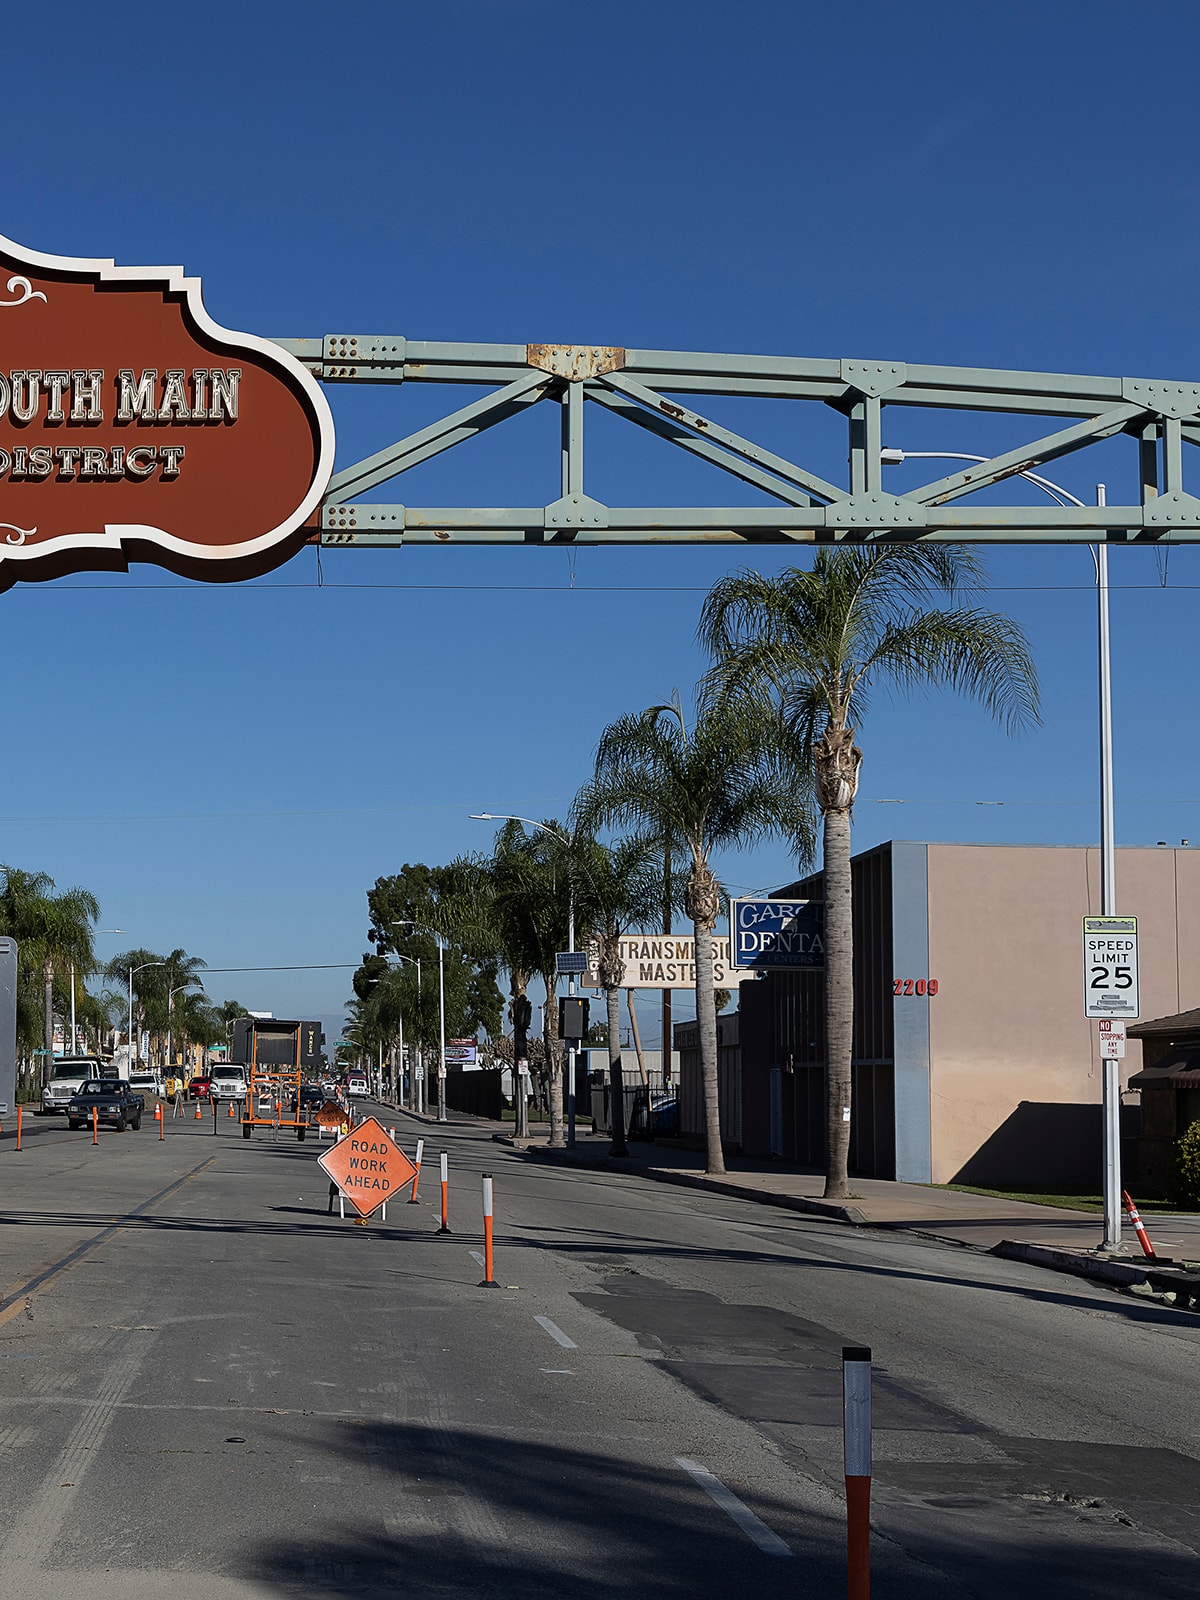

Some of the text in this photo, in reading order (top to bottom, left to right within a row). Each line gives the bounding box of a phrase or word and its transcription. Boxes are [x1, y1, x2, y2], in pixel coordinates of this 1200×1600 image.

[117, 368, 242, 424] MAIN
[739, 931, 824, 953] DENTA
[1089, 940, 1134, 951] SPEED
[618, 941, 731, 960] TRANSMISI
[1093, 953, 1129, 963] LIMIT
[767, 955, 814, 964] CENTERS
[639, 963, 725, 981] MASTES
[1090, 966, 1133, 989] 25
[893, 978, 939, 996] 2209
[1100, 1021, 1110, 1031] NO
[1101, 1033, 1124, 1041] STOPPING
[351, 1140, 388, 1155] ROAD
[349, 1157, 387, 1173] WORK
[344, 1175, 390, 1191] AHEAD
